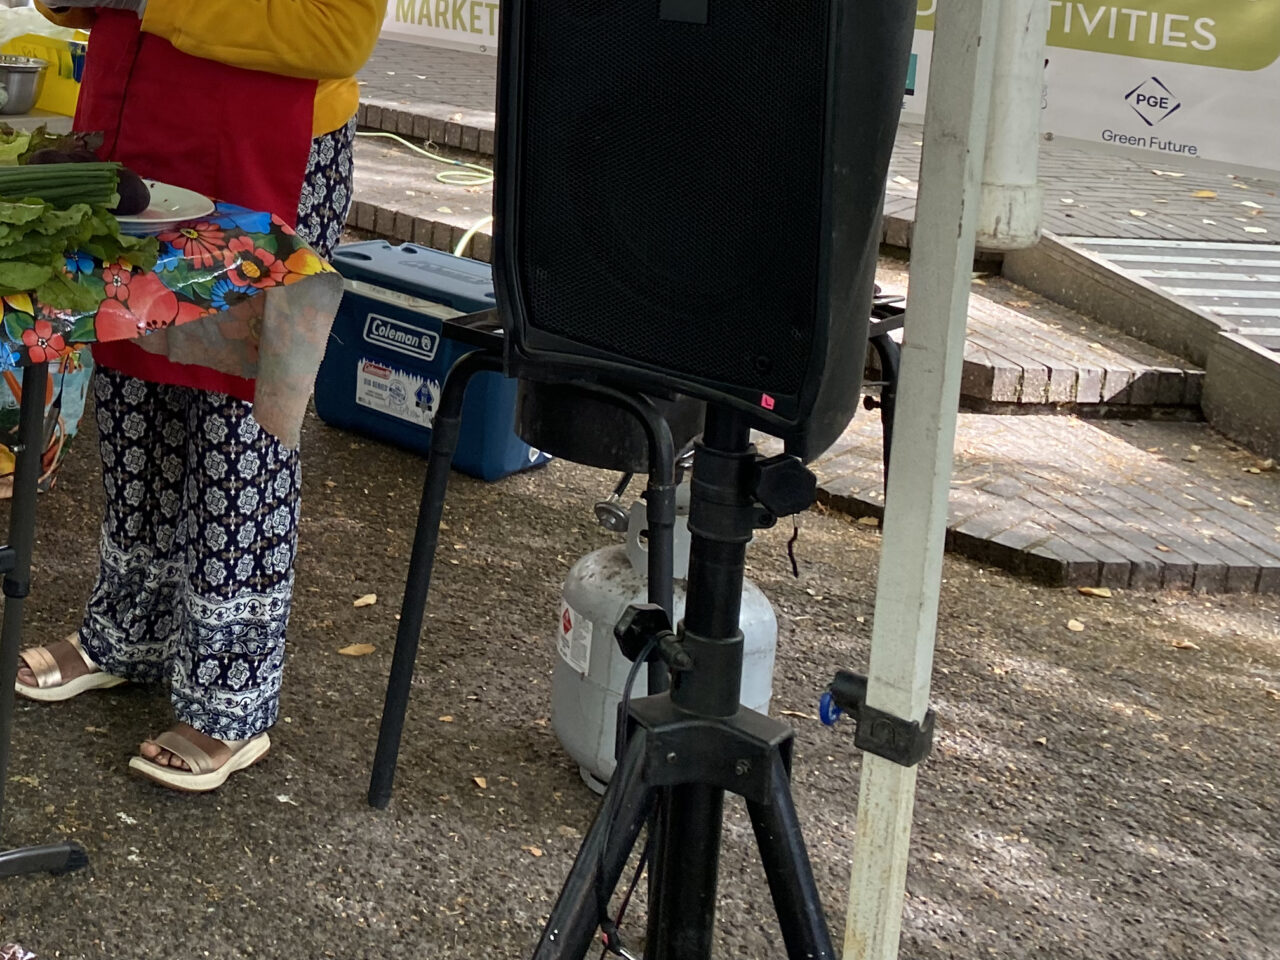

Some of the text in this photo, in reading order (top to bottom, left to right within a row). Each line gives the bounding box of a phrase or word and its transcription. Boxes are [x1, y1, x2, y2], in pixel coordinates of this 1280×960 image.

[1046, 0, 1218, 51] TIVITIES
[1136, 93, 1169, 110] PGE
[1101, 129, 1198, 156] Green Future
[371, 319, 420, 347] Coleman
